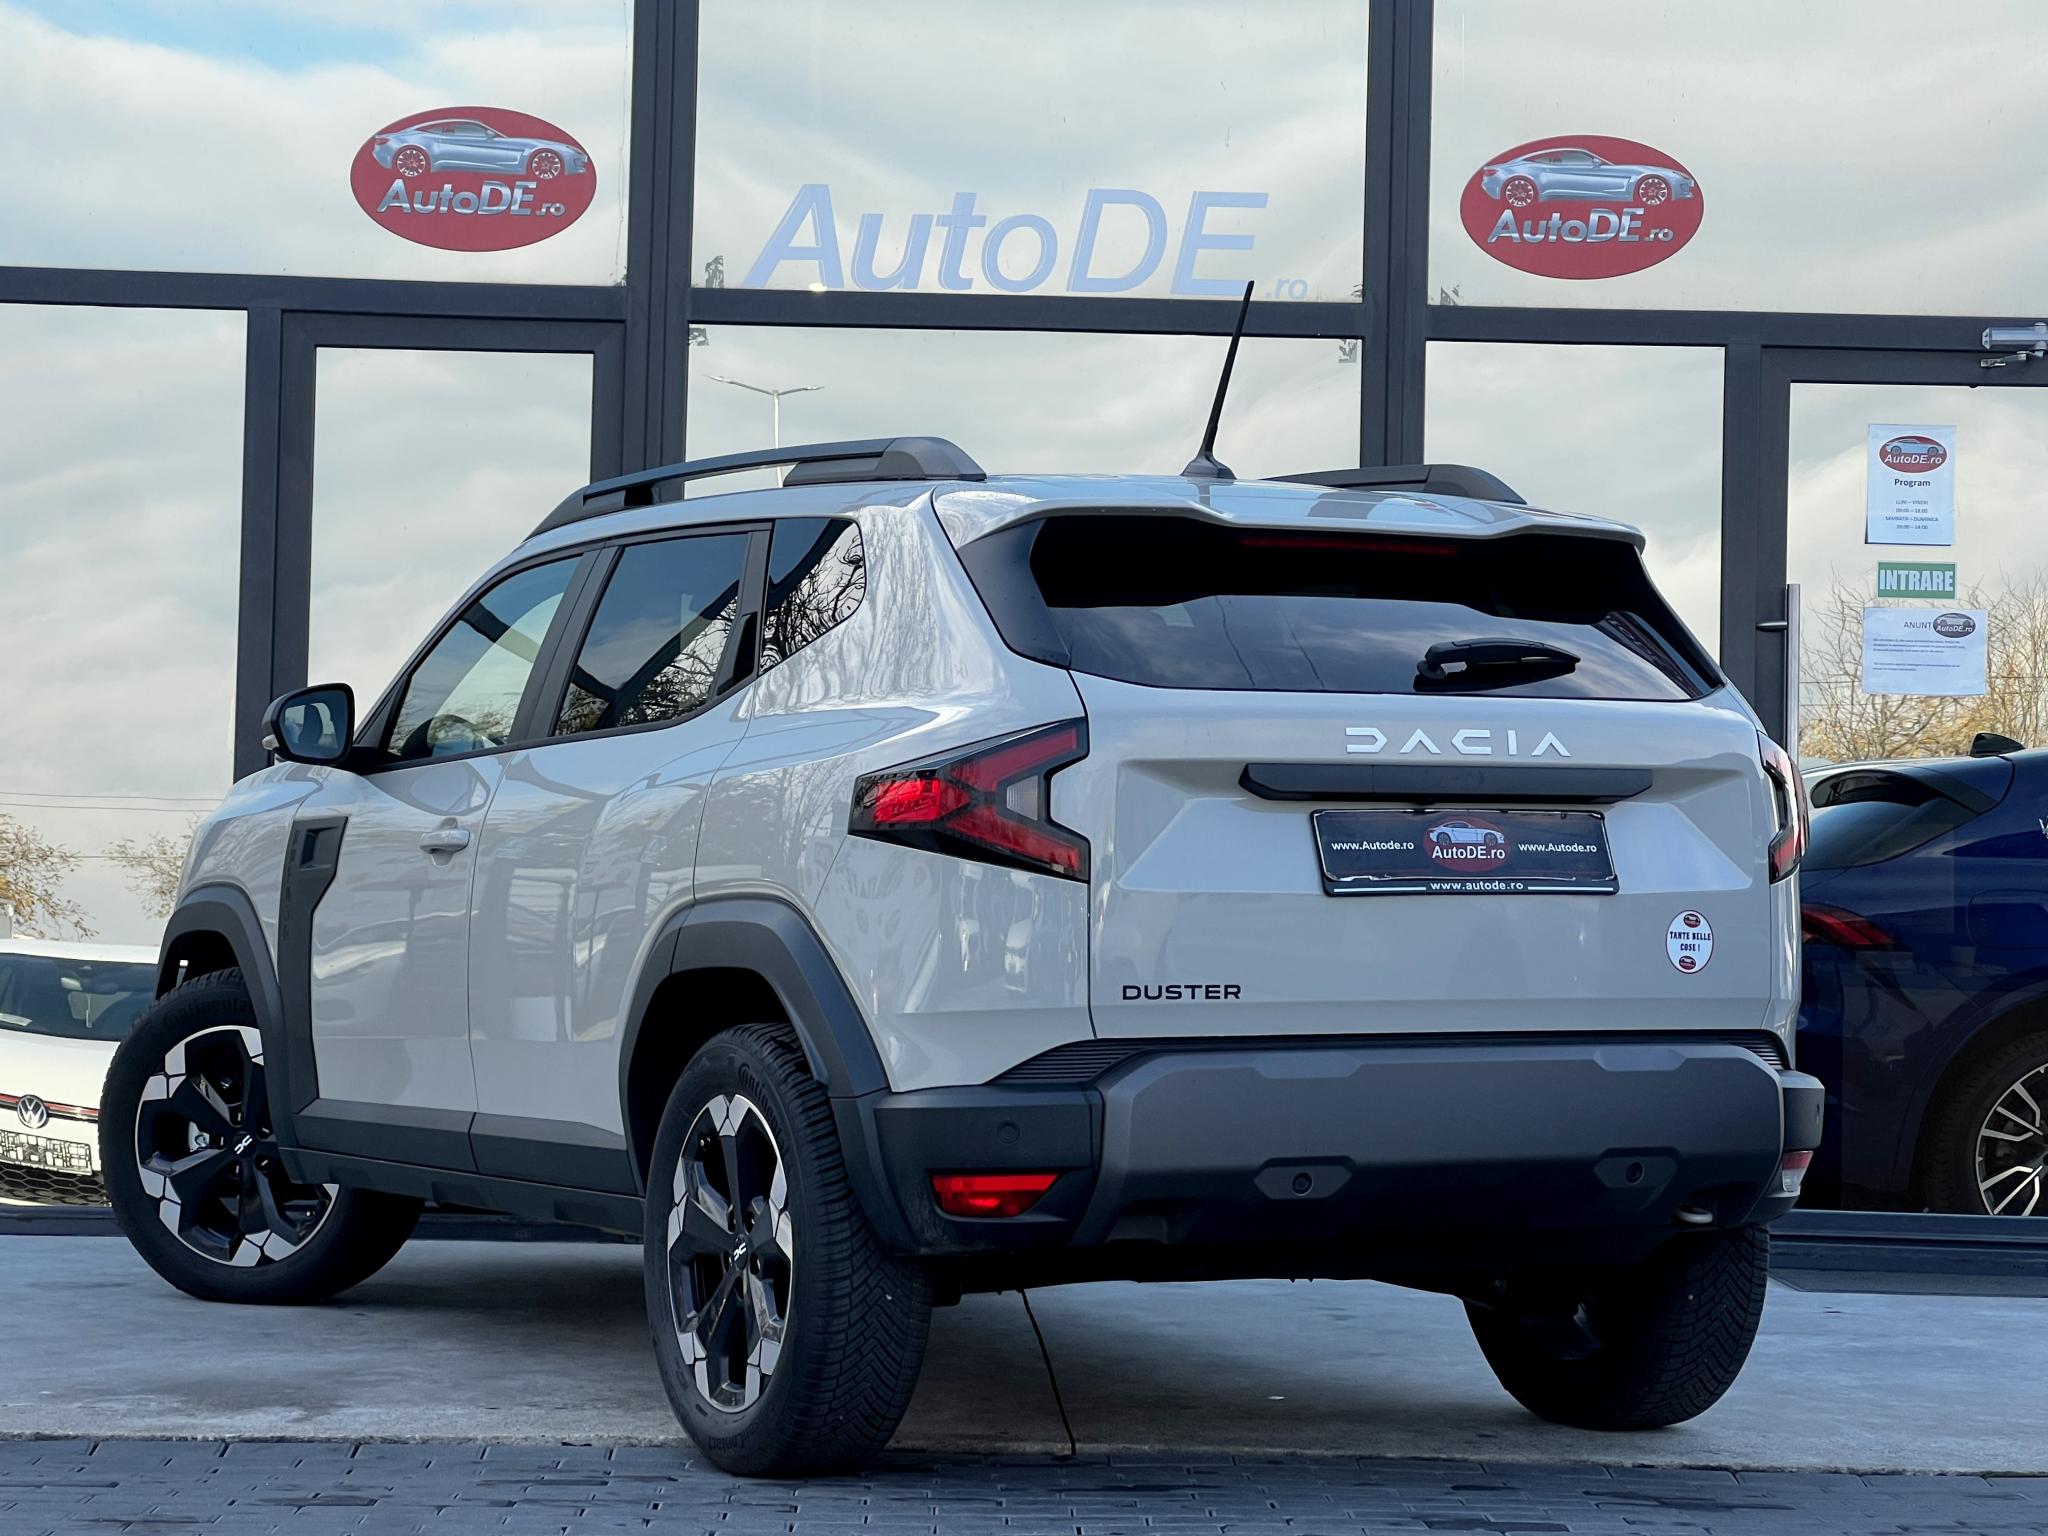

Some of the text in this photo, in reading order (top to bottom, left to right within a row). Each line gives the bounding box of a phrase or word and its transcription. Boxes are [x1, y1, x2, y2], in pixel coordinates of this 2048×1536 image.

[1884, 454, 1943, 464] AutoDE.ro
[1894, 478, 1931, 488] Program
[1879, 569, 1954, 592] INTRARE
[1345, 727, 1572, 757] DACIA
[1331, 840, 1415, 851] www.Autode.ro
[1518, 842, 1597, 853] www.Autode.ro
[1432, 845, 1505, 860] AutoDE.ro
[1430, 880, 1524, 891] www.autode.ro
[1670, 931, 1711, 941] TANTE BELLE
[1680, 943, 1696, 951] COSE
[1122, 984, 1242, 1000] DUSTER
